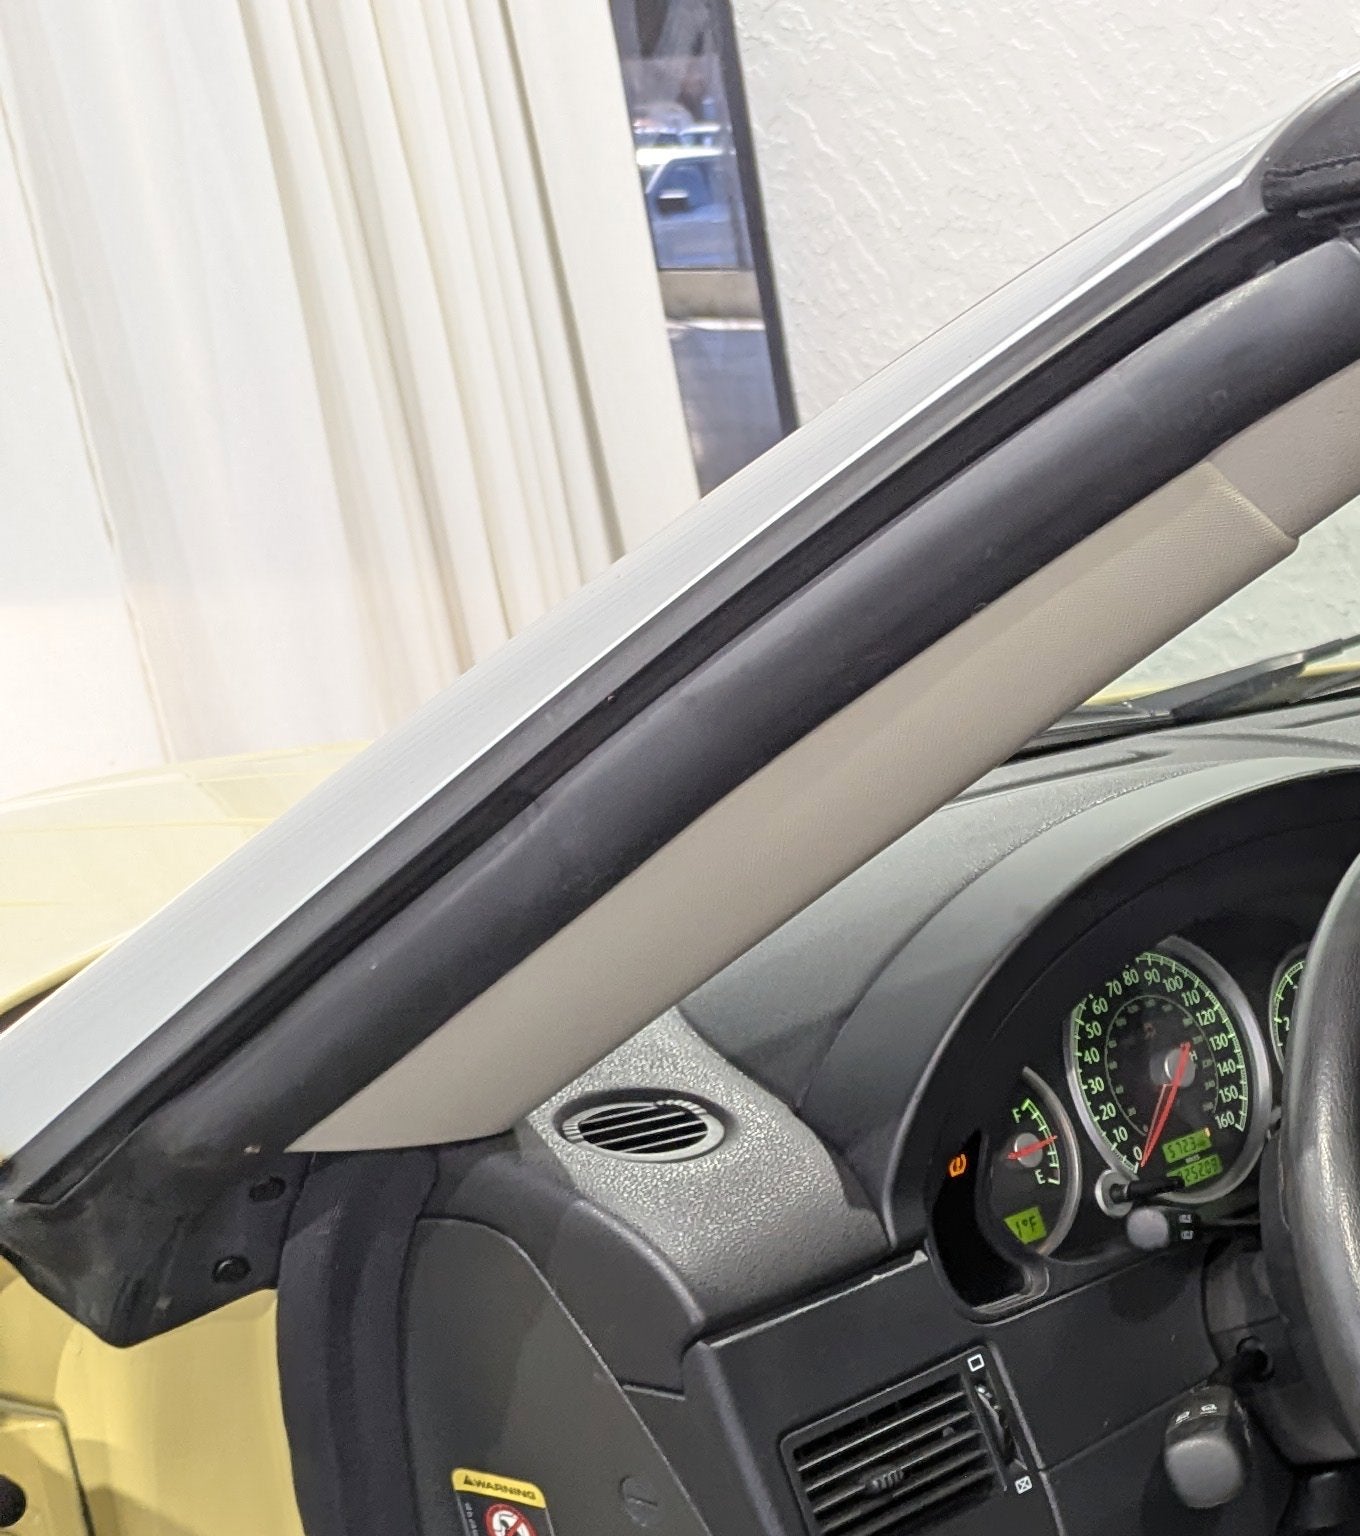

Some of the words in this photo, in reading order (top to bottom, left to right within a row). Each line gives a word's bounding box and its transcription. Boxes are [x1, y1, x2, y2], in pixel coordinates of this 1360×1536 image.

[1123, 969, 1140, 986] 80
[1144, 969, 1160, 985] 90
[1163, 976, 1184, 992] 100
[1105, 980, 1123, 998] 70
[1091, 997, 1109, 1015] 60
[1182, 990, 1201, 1007] 110
[1196, 1009, 1216, 1026] 120
[1086, 1021, 1102, 1039] 50
[1209, 1033, 1229, 1051] 130
[1084, 1047, 1100, 1064] 40
[1216, 1059, 1236, 1076] 140
[1088, 1076, 1105, 1095] 30
[1219, 1085, 1238, 1103] 150
[1011, 1107, 1022, 1124] F
[1099, 1102, 1117, 1121] 20
[1214, 1111, 1235, 1129] 160
[1112, 1126, 1128, 1144] 10
[1132, 1145, 1143, 1161] 0
[1034, 1168, 1046, 1185] E
[475, 1479, 537, 1501] WARNING
